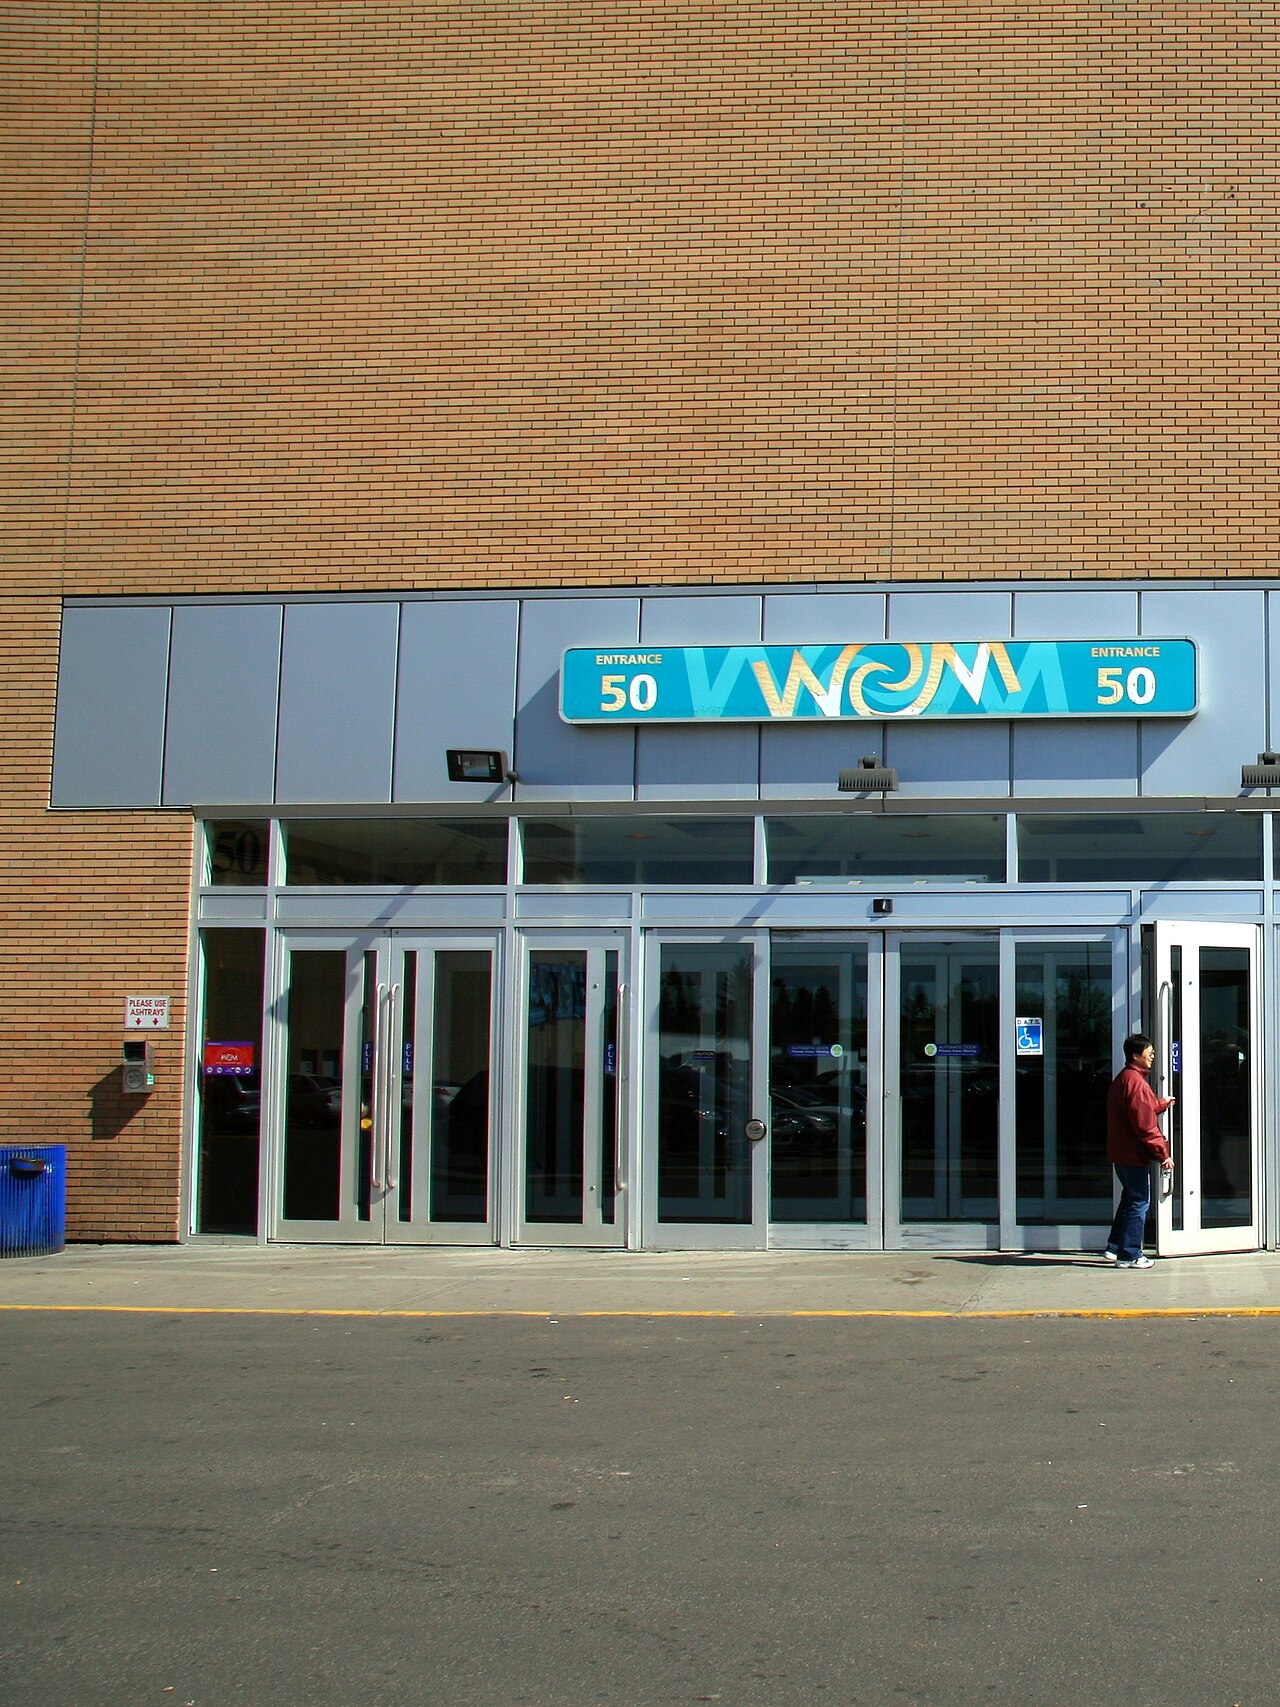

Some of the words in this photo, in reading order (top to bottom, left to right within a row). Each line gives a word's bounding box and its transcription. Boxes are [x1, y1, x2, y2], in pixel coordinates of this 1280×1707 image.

[1090, 646, 1160, 658] ENTRANCE
[595, 653, 662, 666] ENTRANCE
[600, 673, 658, 712] 50
[1096, 666, 1156, 706] 50
[130, 1008, 165, 1016] ASHTRAYS
